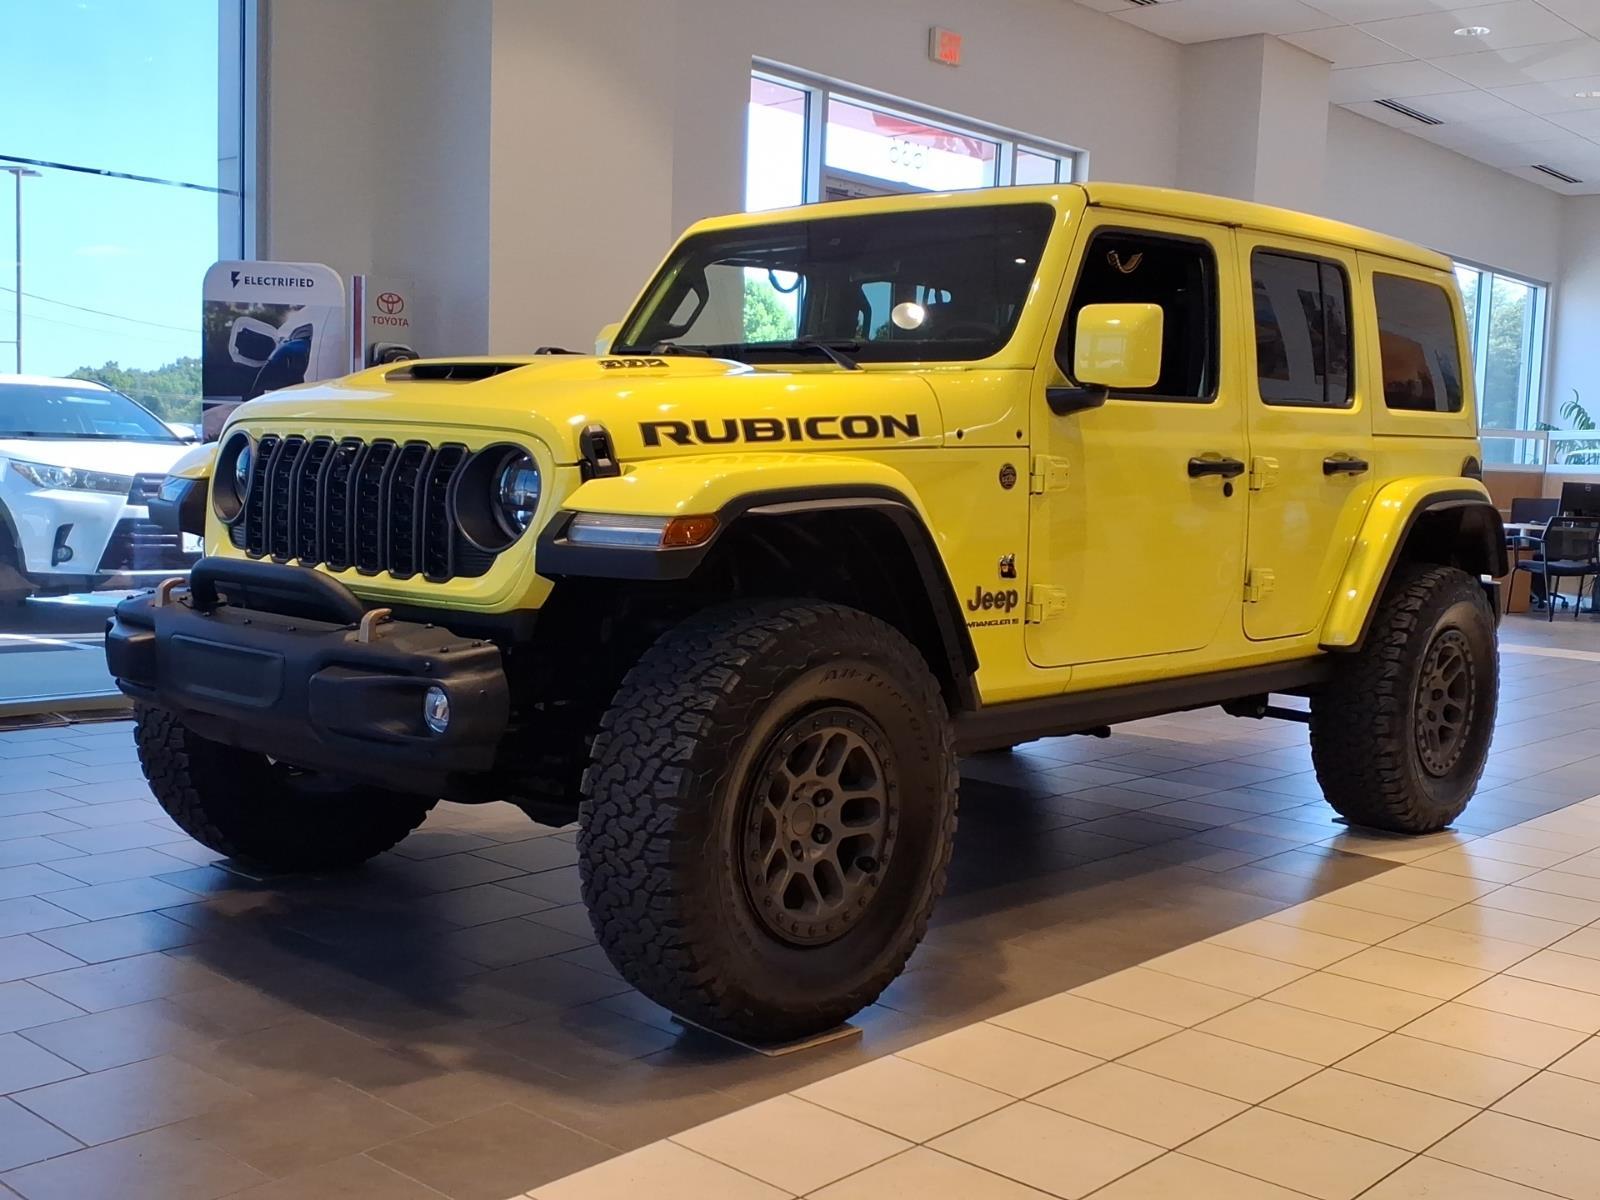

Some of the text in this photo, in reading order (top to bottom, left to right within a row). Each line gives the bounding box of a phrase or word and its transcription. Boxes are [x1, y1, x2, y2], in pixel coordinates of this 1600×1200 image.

[244, 275, 314, 288] ELECTRIFIED
[372, 316, 409, 327] TOYOTA
[638, 414, 920, 448] RUBICON
[967, 586, 1018, 613] Jeep
